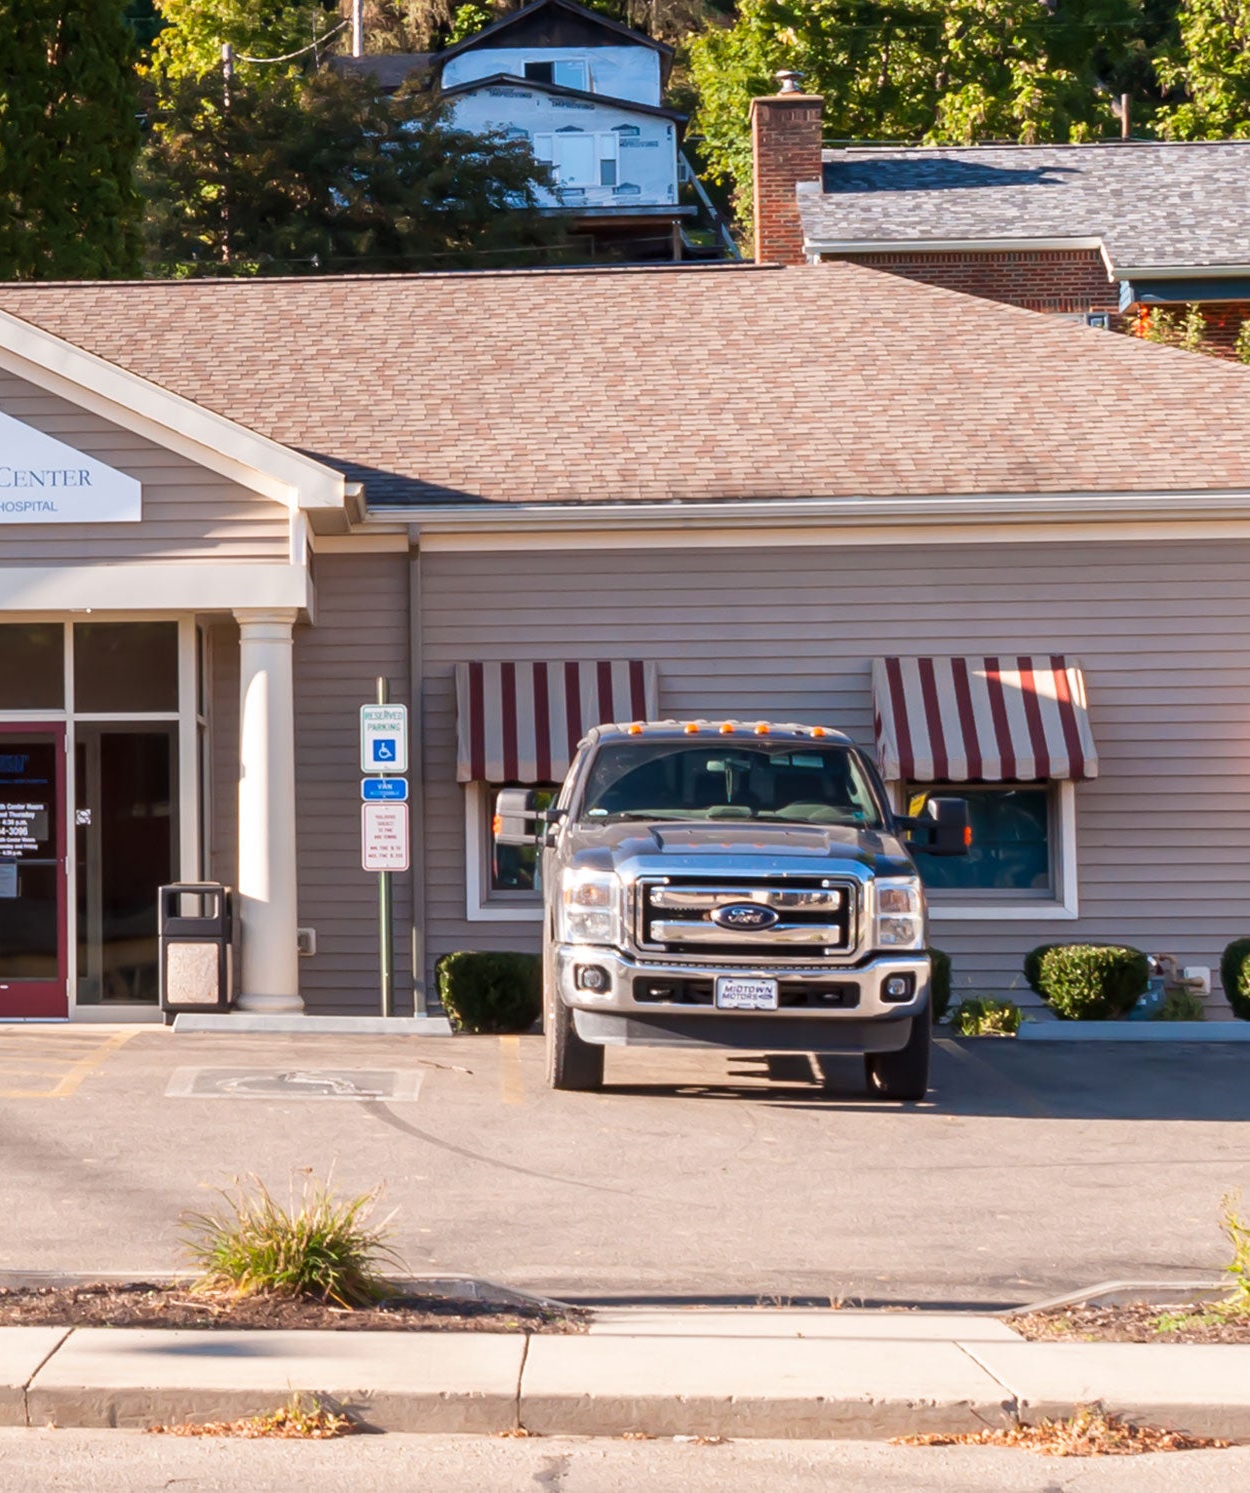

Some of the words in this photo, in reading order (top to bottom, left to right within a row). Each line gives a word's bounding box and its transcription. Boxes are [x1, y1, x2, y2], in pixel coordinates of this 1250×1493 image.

[363, 711, 403, 719] RESERVED
[367, 722, 401, 731] PARKING
[6, 803, 26, 811] Center
[8, 811, 36, 820] Thursday
[728, 908, 763, 924] Ford
[724, 985, 773, 994] MIDTOWN
[721, 992, 759, 1000] MOTORS
